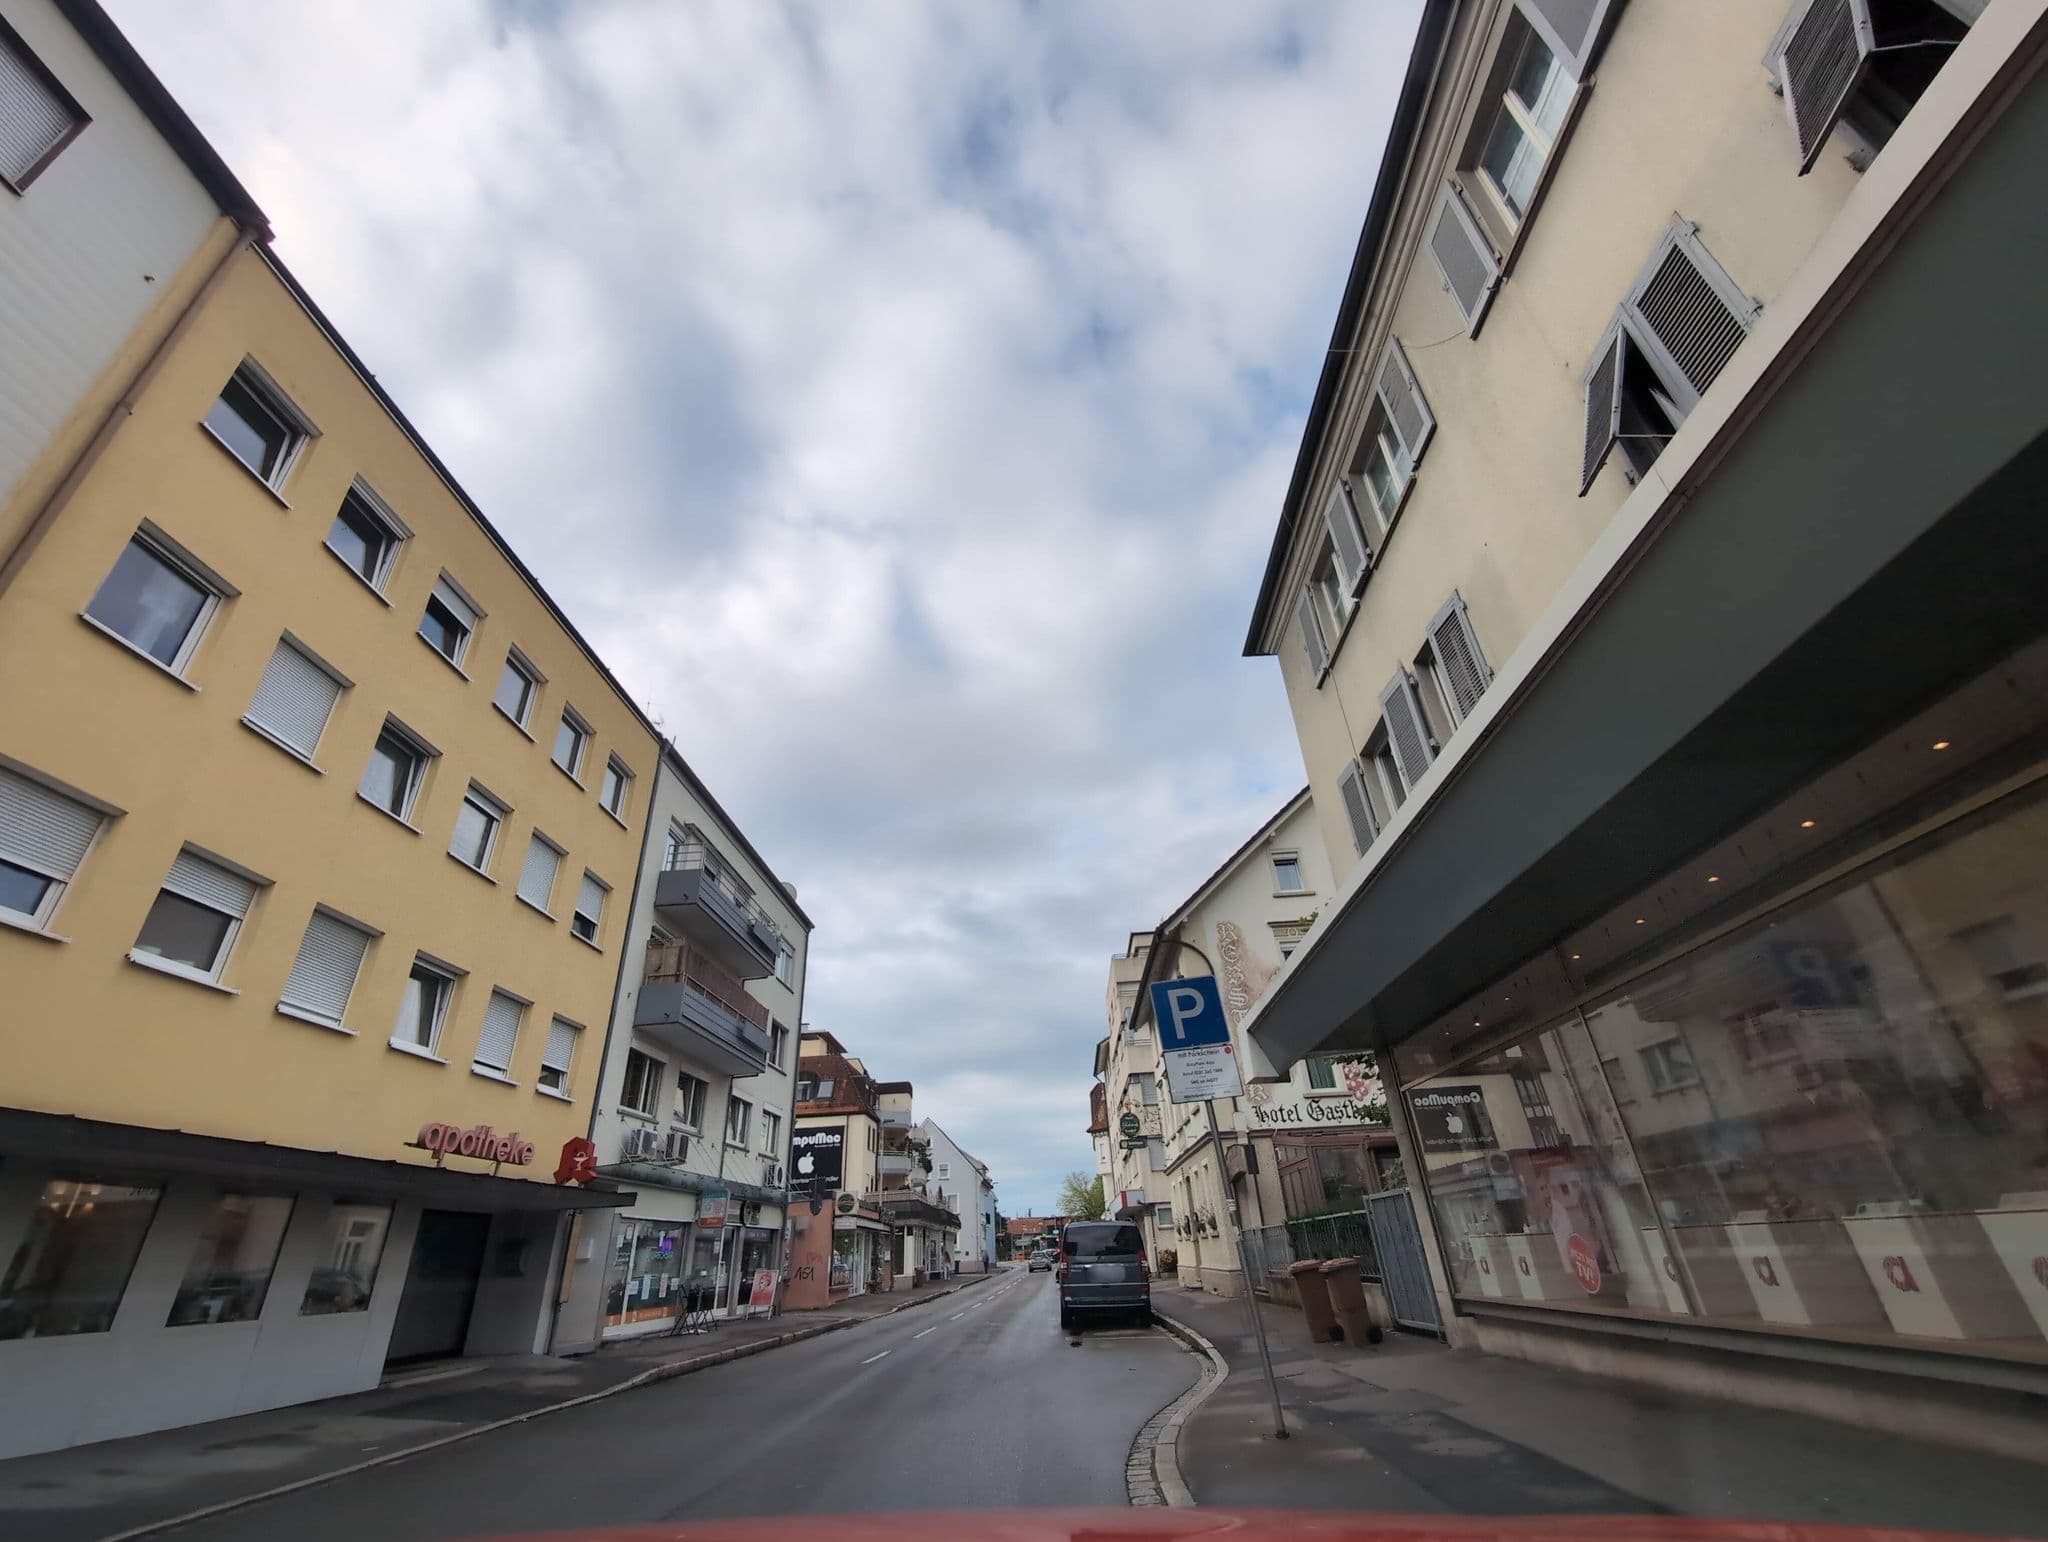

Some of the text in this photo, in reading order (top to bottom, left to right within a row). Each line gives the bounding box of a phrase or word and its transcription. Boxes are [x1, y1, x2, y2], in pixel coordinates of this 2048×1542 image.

[1167, 987, 1205, 1040] P
[1252, 1103, 1303, 1123] Hotel
[418, 1122, 536, 1165] apotheke
[793, 1132, 841, 1148] mpuMac
